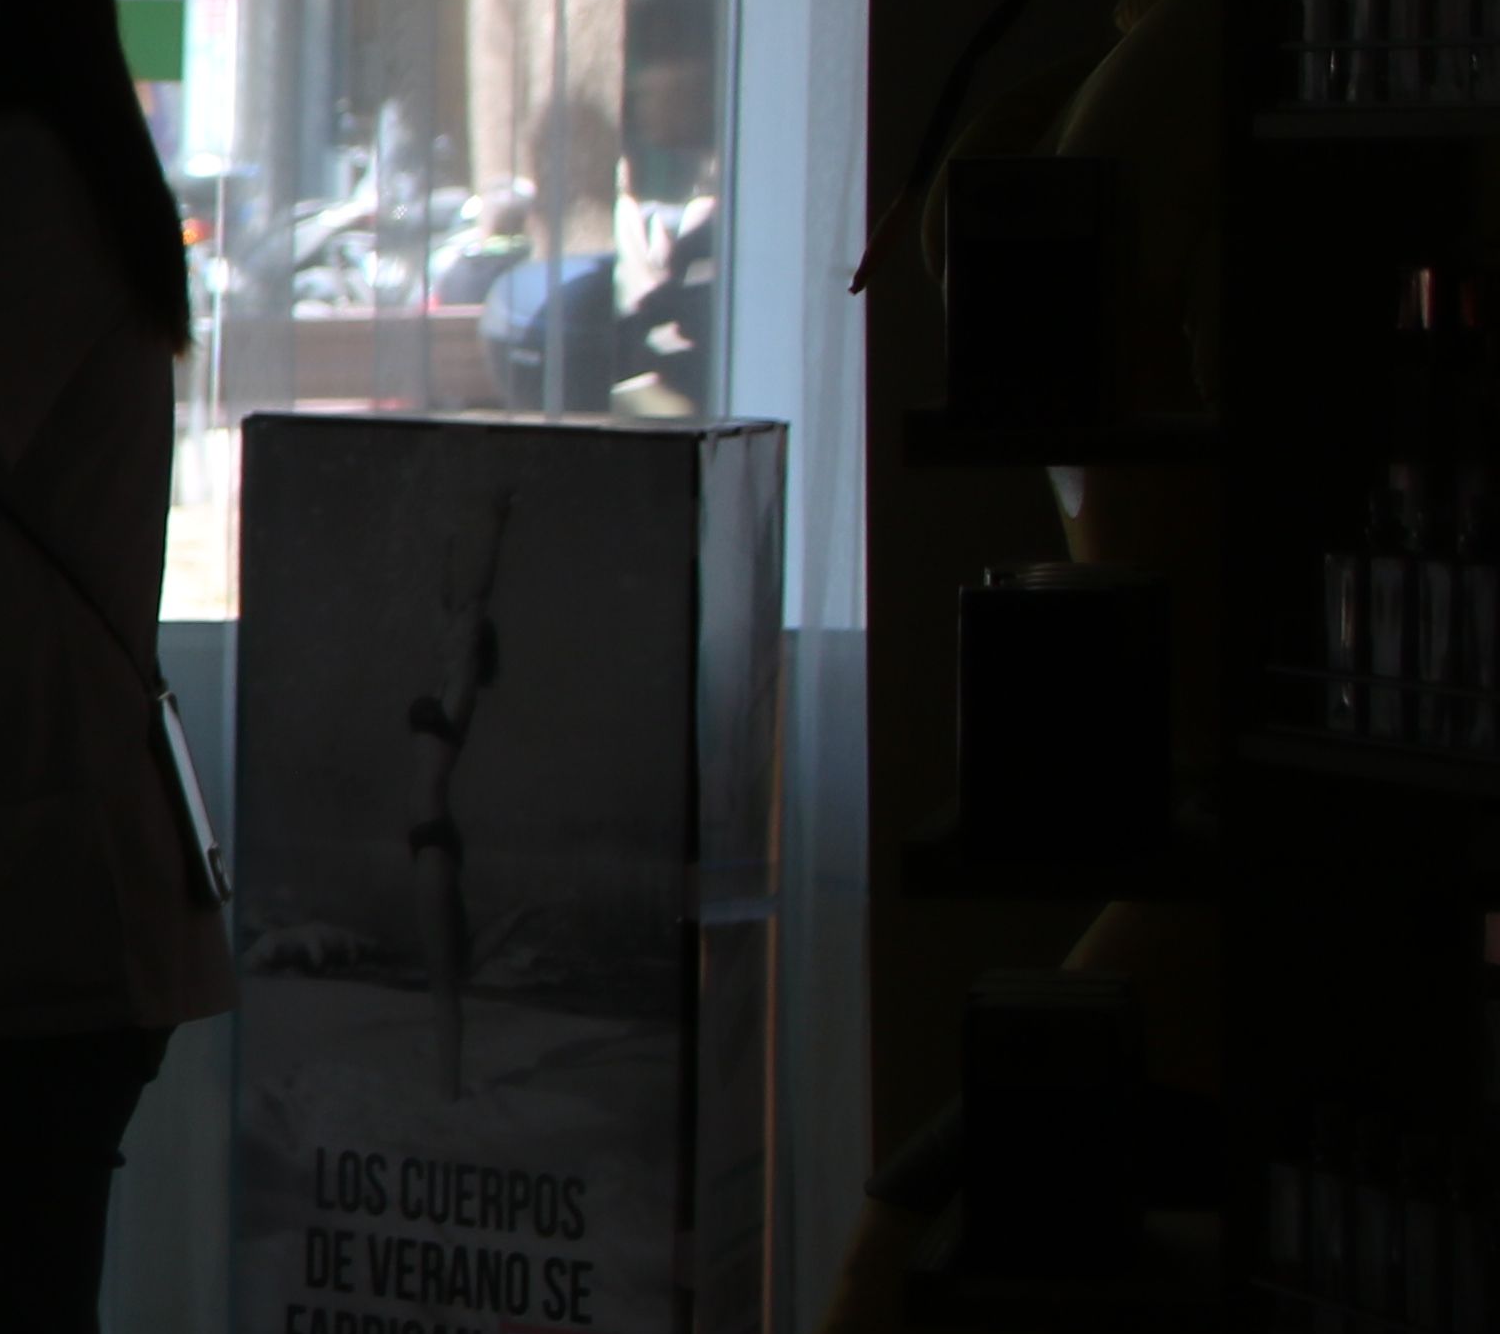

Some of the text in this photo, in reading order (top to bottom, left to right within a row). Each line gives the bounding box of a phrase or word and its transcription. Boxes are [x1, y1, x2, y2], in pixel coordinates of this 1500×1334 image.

[316, 1147, 586, 1241] LOS CUERPOS
[306, 1227, 593, 1324] DE VERANO SE
